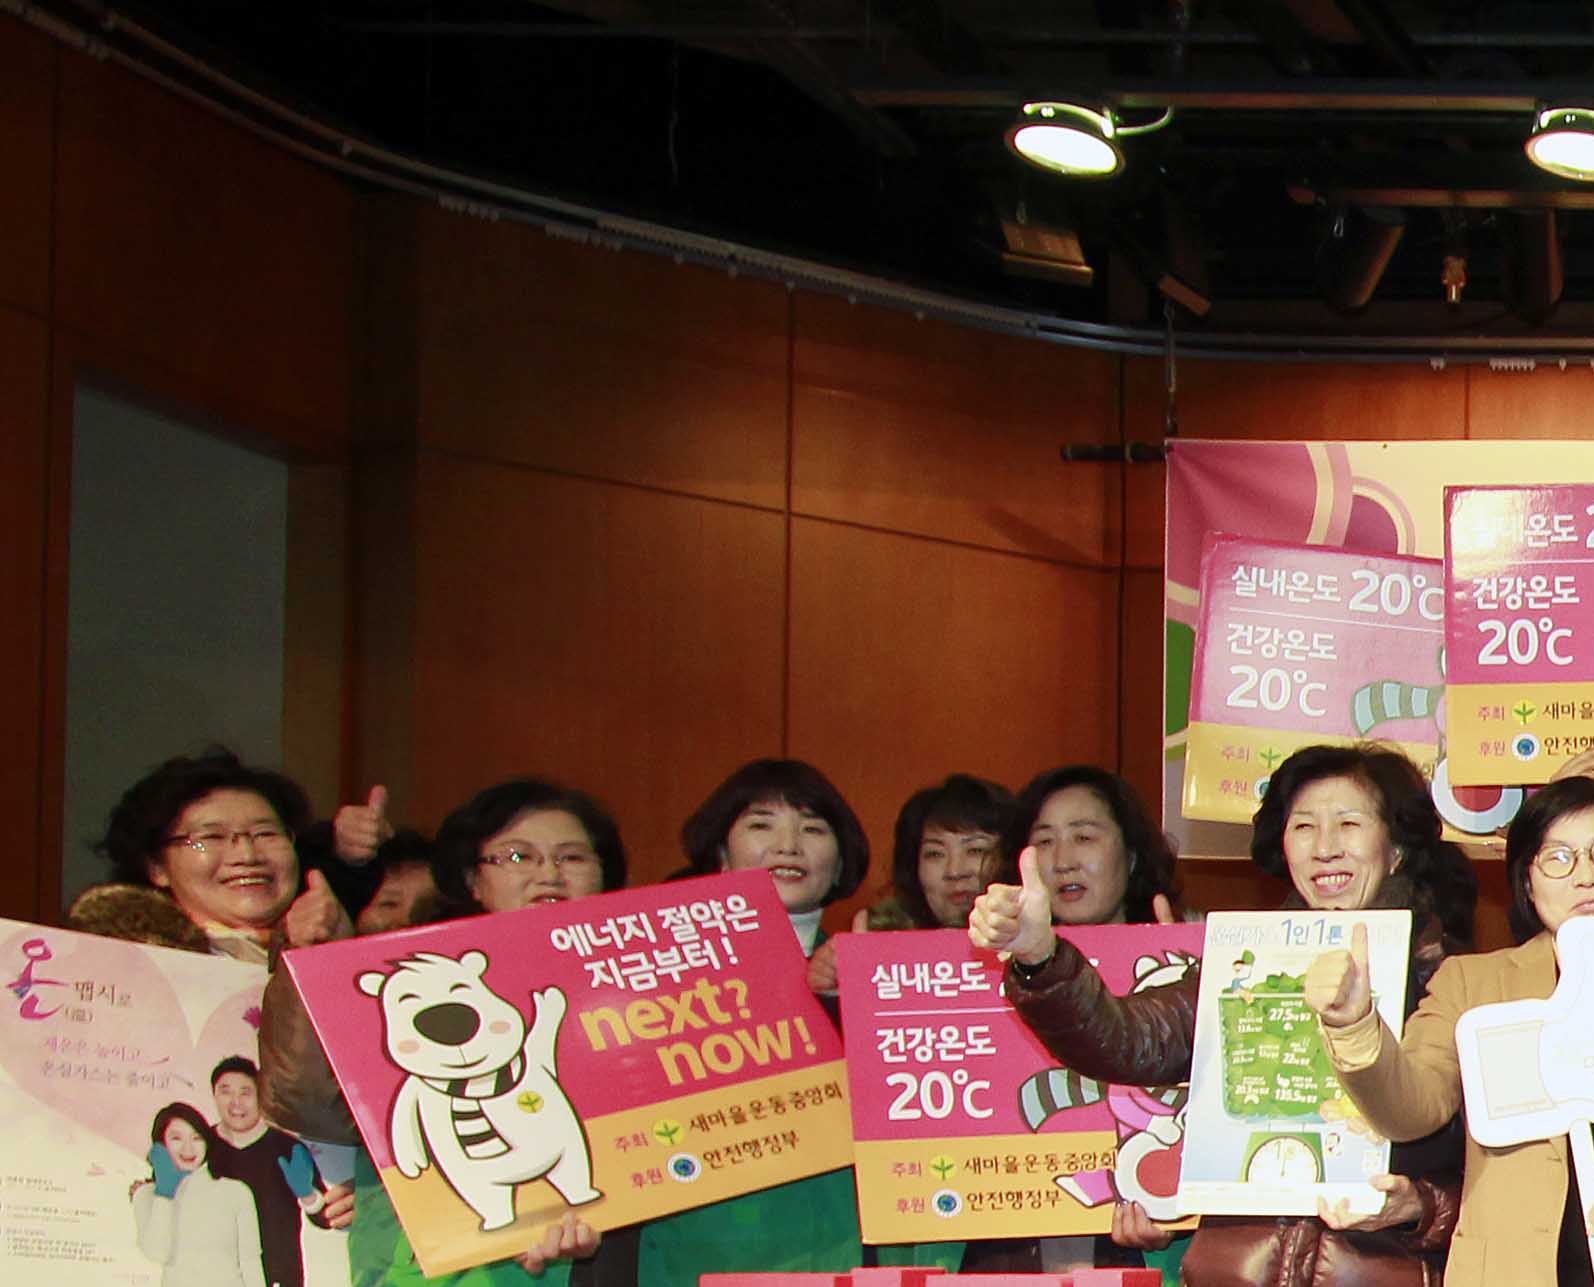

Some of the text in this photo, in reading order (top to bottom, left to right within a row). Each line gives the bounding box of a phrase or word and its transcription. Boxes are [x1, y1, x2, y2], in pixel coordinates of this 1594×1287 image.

[1231, 564, 1342, 604] 실내온도
[1472, 575, 1580, 611] 건강온도
[1226, 622, 1338, 662] 건강온도
[549, 894, 760, 960] 에너지 절약은
[870, 960, 992, 1000] 실내온도
[578, 976, 752, 1053] next?
[656, 1015, 817, 1087] now!
[875, 1025, 998, 1063] 건강온도
[613, 1081, 844, 1154] 주최 새마을운동중앙회
[702, 1131, 801, 1171] 안전행정부
[891, 1149, 1118, 1178] 주최 새마을운동중앙회
[966, 1189, 1062, 1213] 안전행정부
